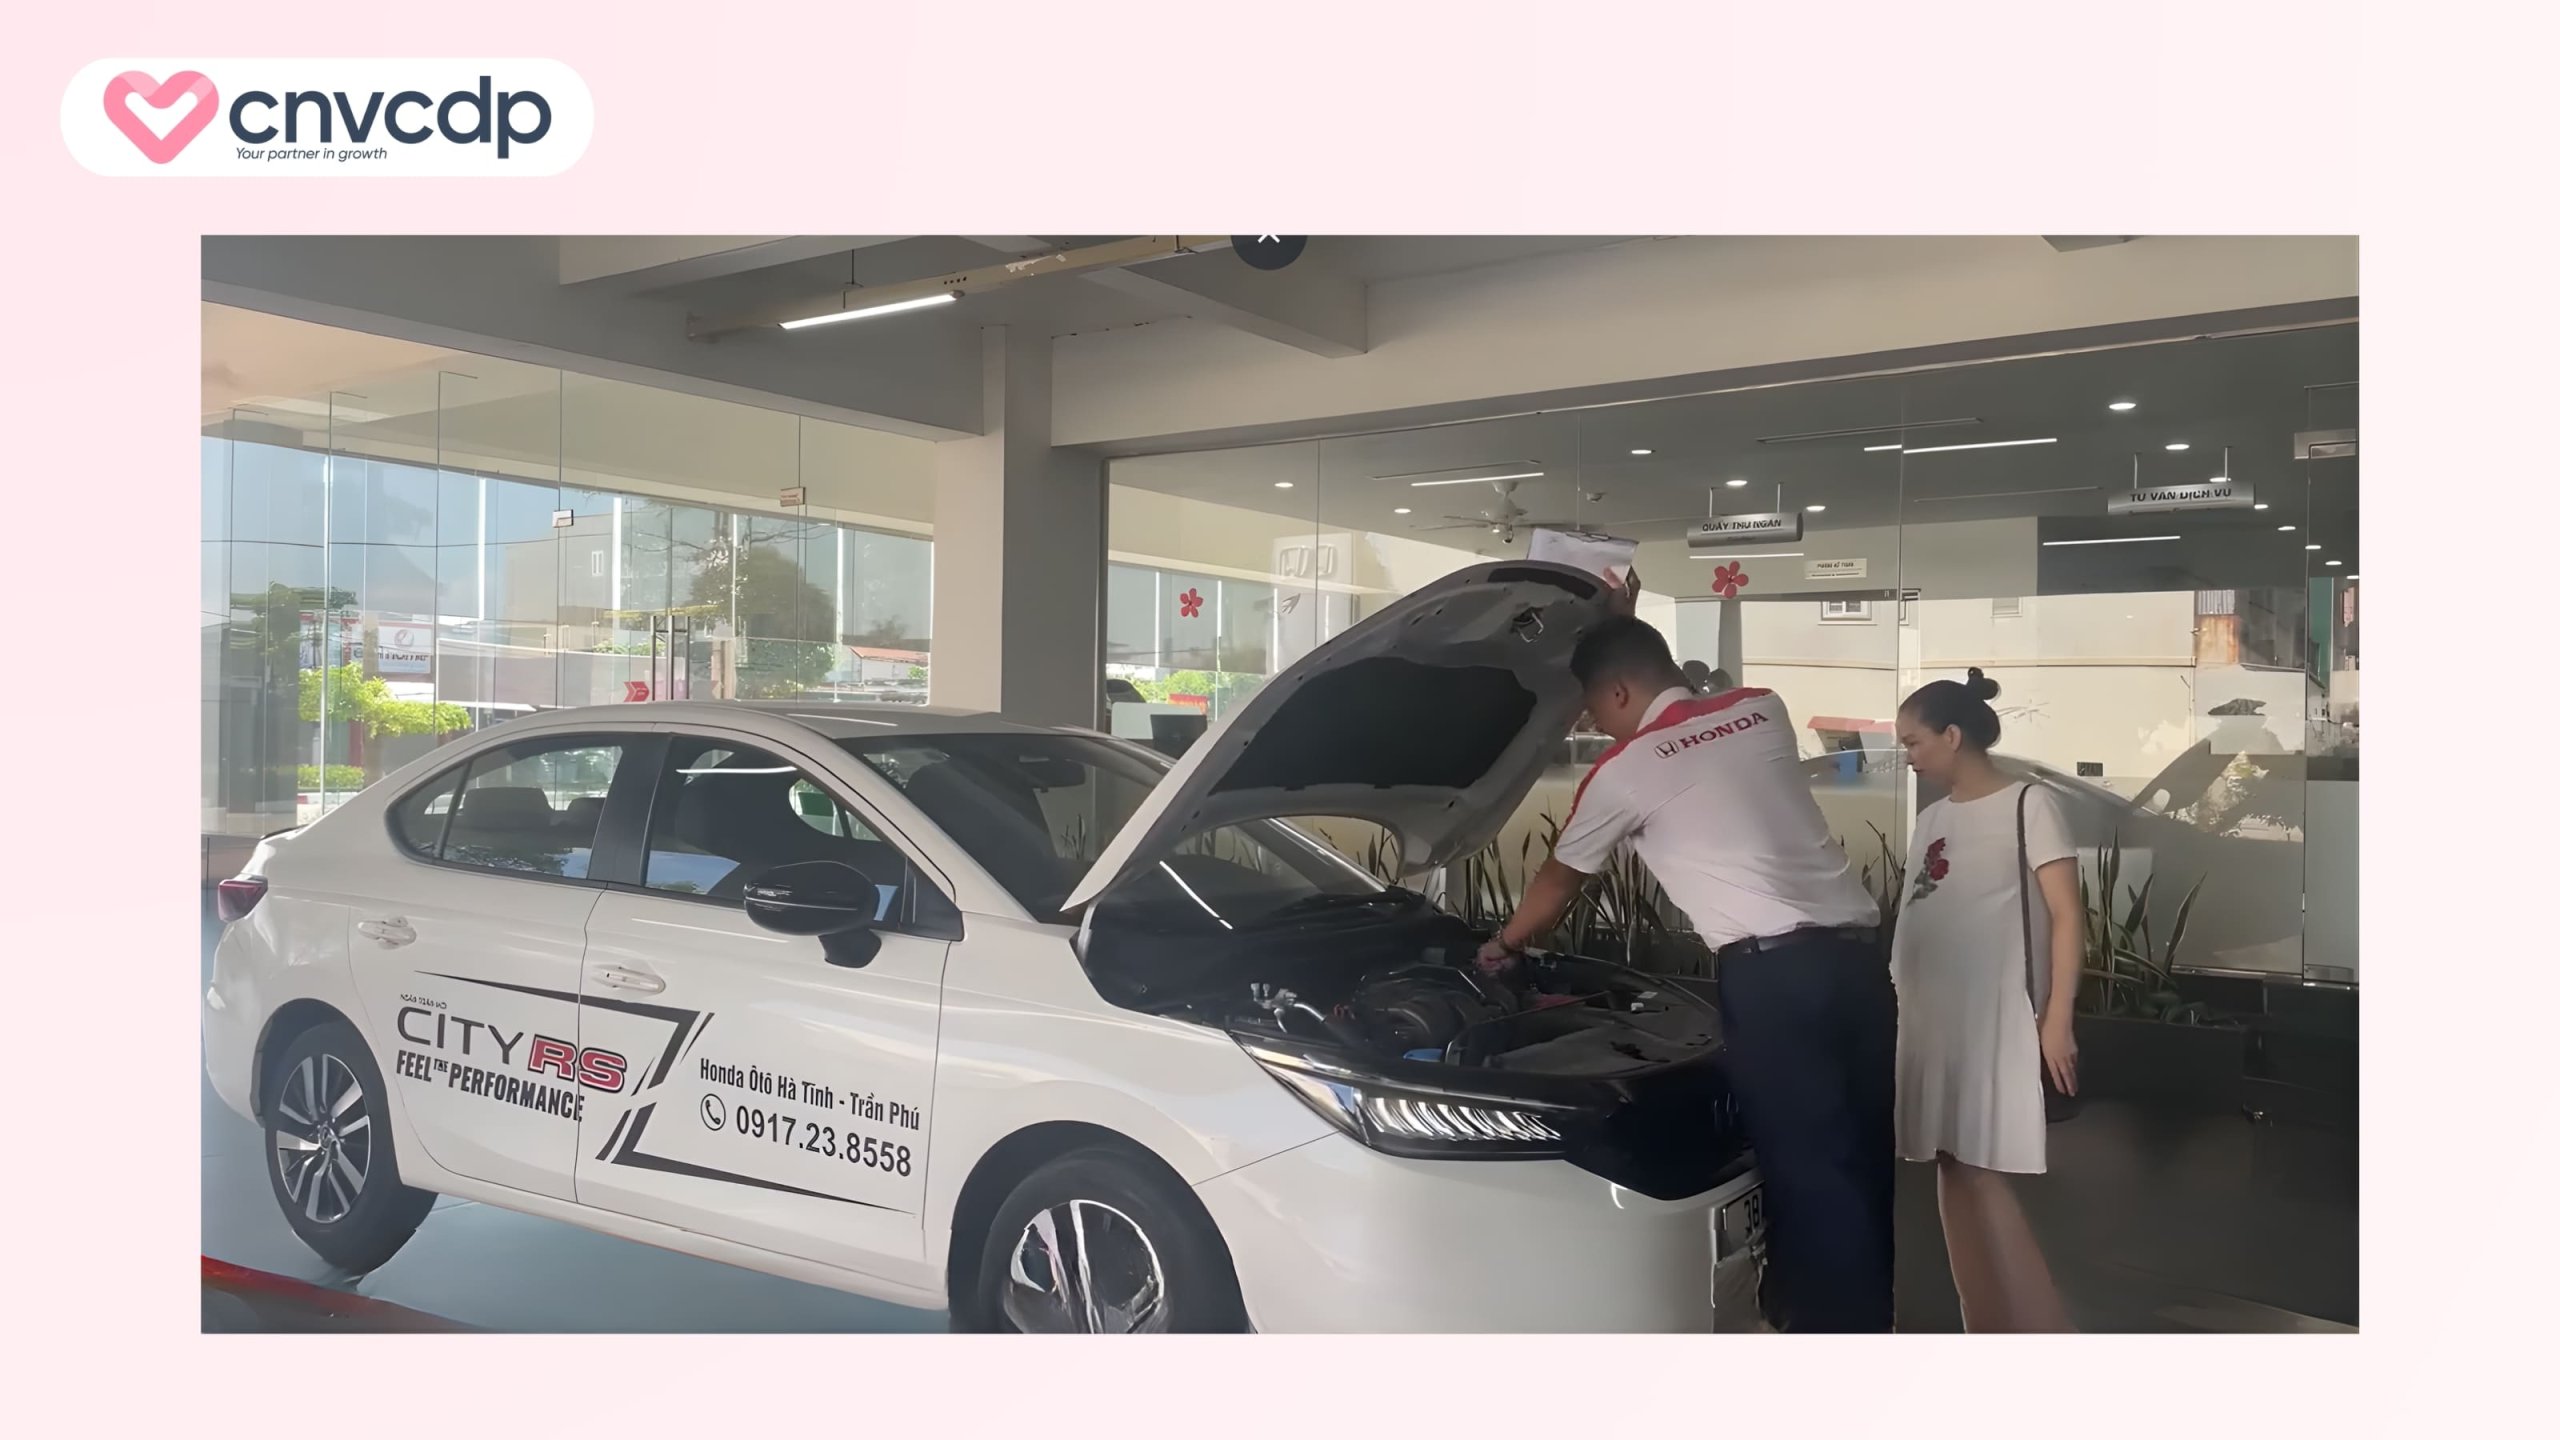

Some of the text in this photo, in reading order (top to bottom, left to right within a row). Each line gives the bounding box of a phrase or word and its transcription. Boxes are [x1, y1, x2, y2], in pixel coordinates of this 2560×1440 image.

[1678, 712, 1769, 749] HONDA
[396, 1049, 432, 1083] FEEL
[448, 1062, 585, 1123] PERFORMANCE
[397, 1006, 628, 1094] CITY RS
[700, 1058, 744, 1089] Honda
[749, 1065, 772, 1095] Ôtô
[778, 1075, 796, 1101] Hà
[850, 1091, 884, 1122] Trần
[889, 1101, 920, 1131] Phú
[736, 1105, 912, 1177] 0917.23.8558
